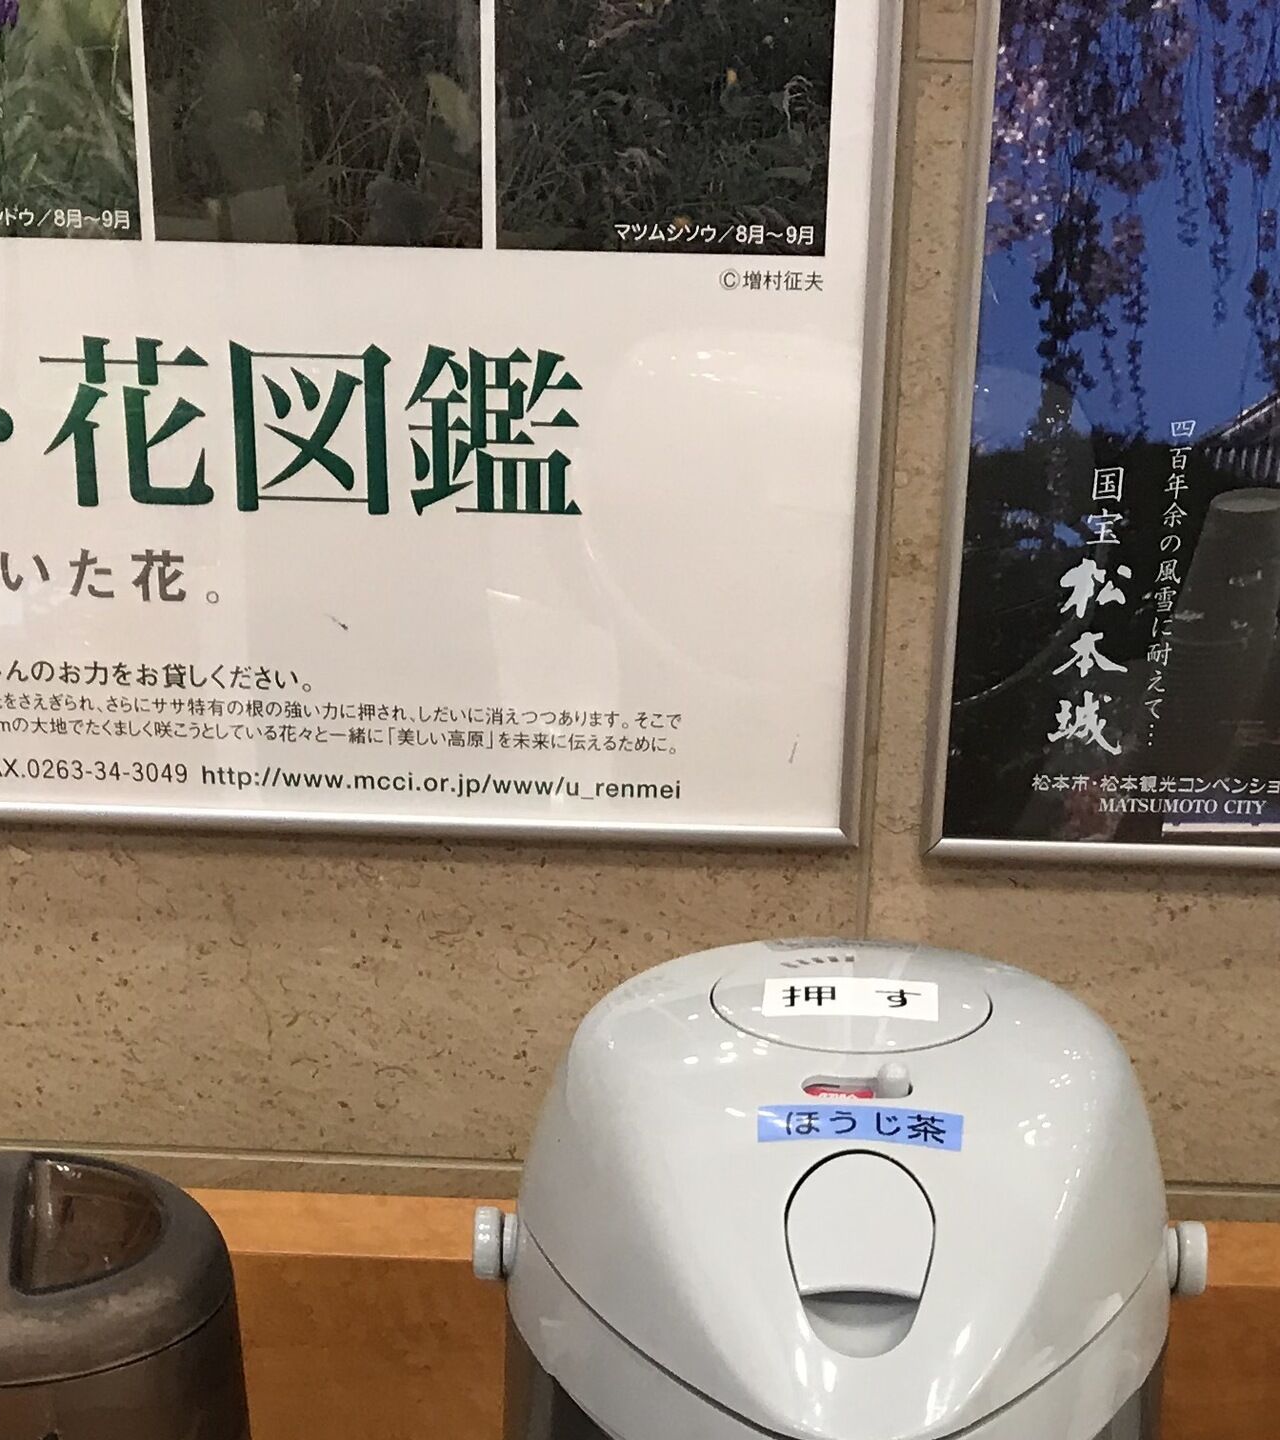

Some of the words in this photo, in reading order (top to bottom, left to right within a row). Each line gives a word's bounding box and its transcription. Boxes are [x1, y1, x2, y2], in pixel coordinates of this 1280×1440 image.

[1086, 465, 1125, 546] 国宝
[1047, 557, 1133, 757] 松本城
[201, 764, 682, 800] http://www.mcci.or.jp/www/u_renmei
[1097, 798, 1219, 815] MATSUMOTO
[1223, 800, 1269, 816] CITY
[785, 1110, 947, 1144] ほうじ茶
